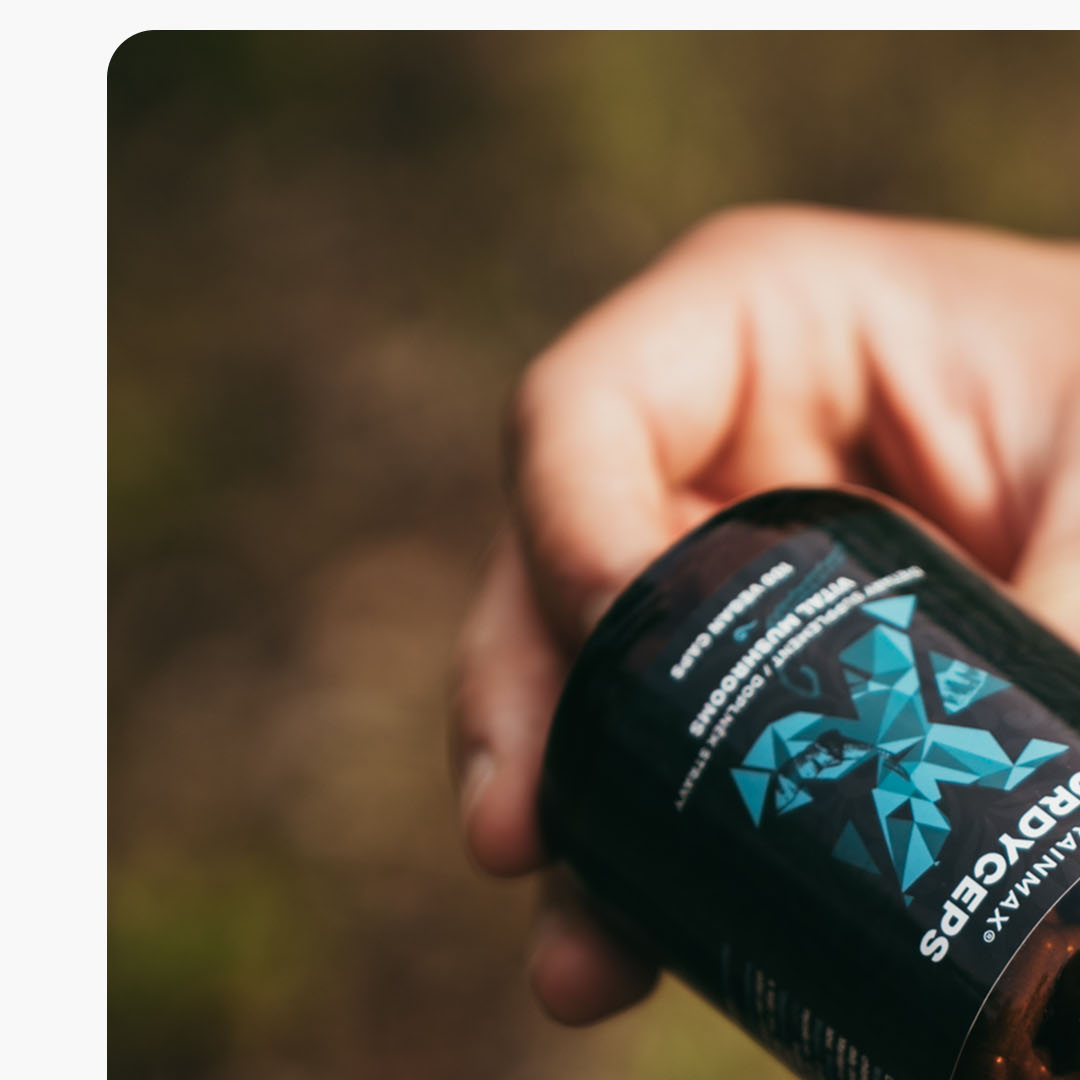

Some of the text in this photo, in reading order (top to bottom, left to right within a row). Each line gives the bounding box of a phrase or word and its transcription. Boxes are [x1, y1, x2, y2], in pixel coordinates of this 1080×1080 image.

[707, 583, 766, 635] VEGAN
[772, 591, 866, 668] SUPPLEMENT
[670, 632, 712, 680] CAPS
[689, 576, 857, 737] VITAL MUSHROOMS
[674, 748, 711, 811] STRAVY
